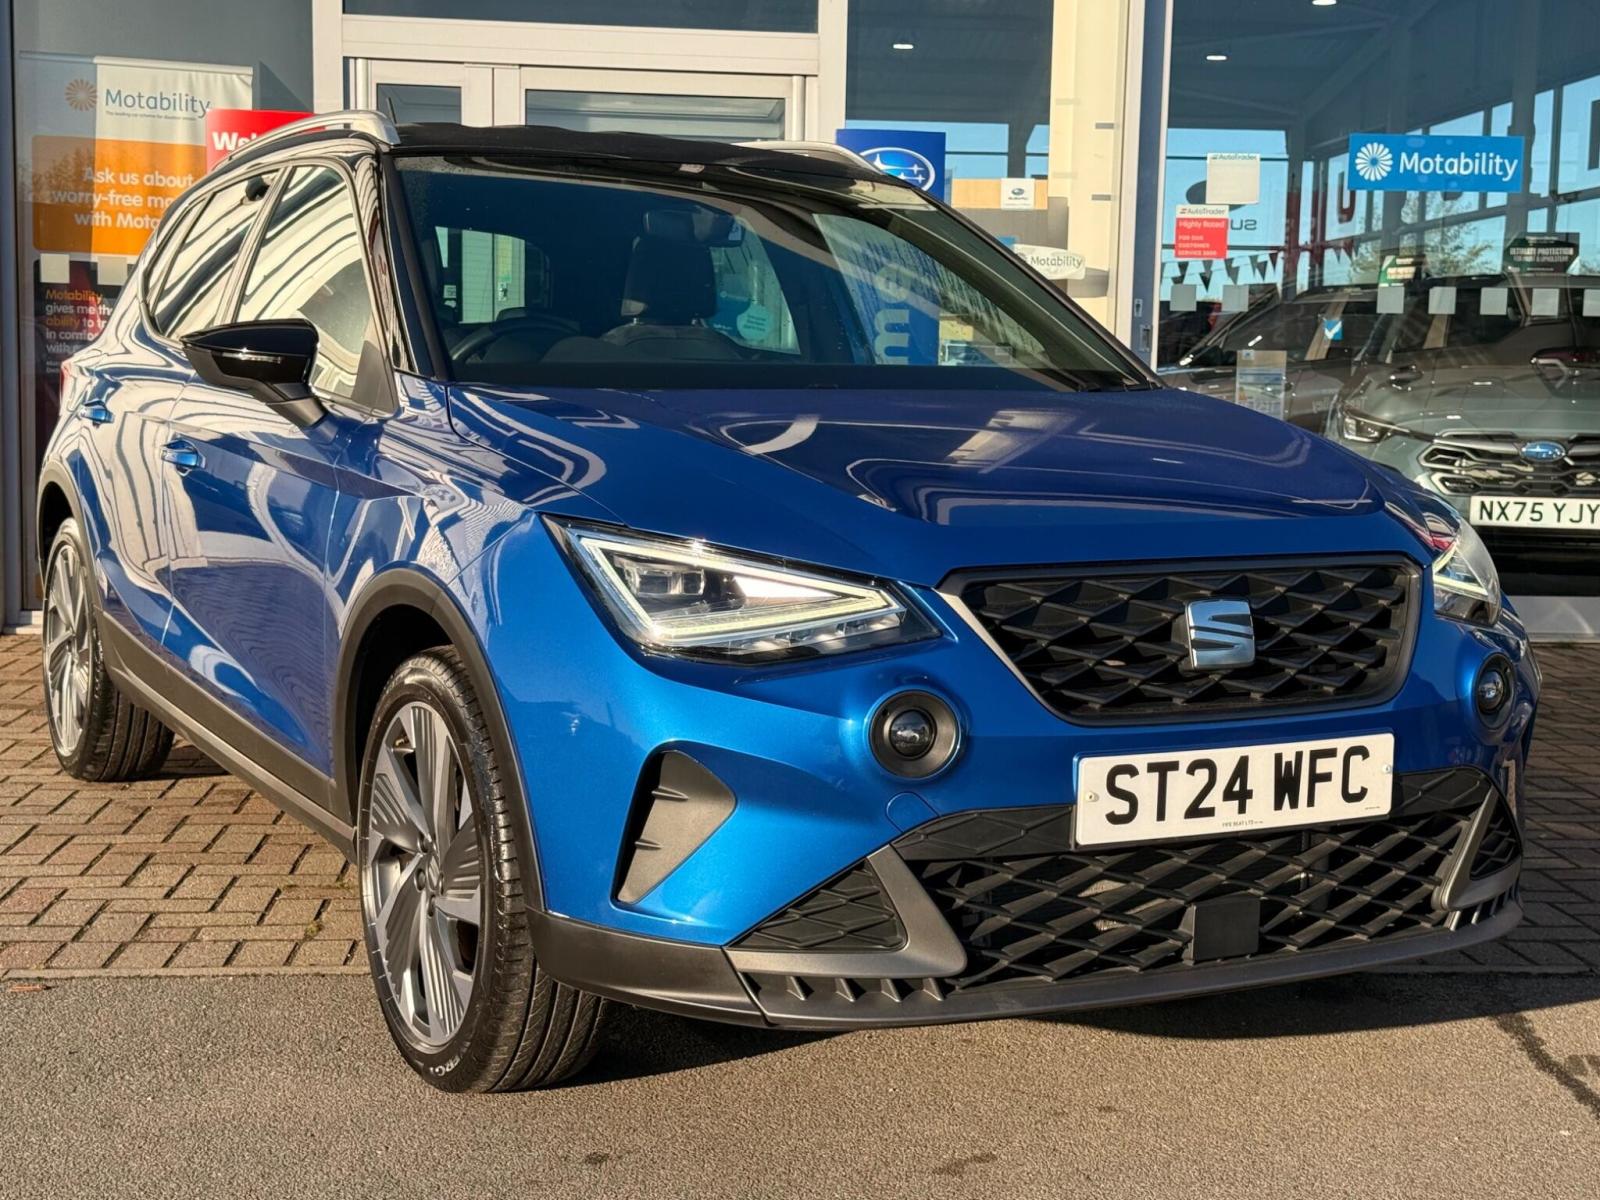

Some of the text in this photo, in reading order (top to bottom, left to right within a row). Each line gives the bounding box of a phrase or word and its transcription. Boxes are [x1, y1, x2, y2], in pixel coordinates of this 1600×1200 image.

[105, 88, 211, 119] Motability
[1399, 151, 1519, 182] Motability
[84, 167, 194, 188] Ask us about
[52, 189, 173, 209] worry-free mo
[74, 210, 161, 230] with Mota
[1187, 207, 1226, 215] AutoTrader
[1030, 255, 1083, 268] Motability
[46, 289, 103, 305] Motability
[45, 303, 74, 316] gives
[76, 305, 96, 315] me
[46, 315, 80, 331] ability
[82, 317, 95, 328] to
[1479, 500, 1600, 524] NX75 YJY
[1105, 745, 1370, 826] ST24 WFC
